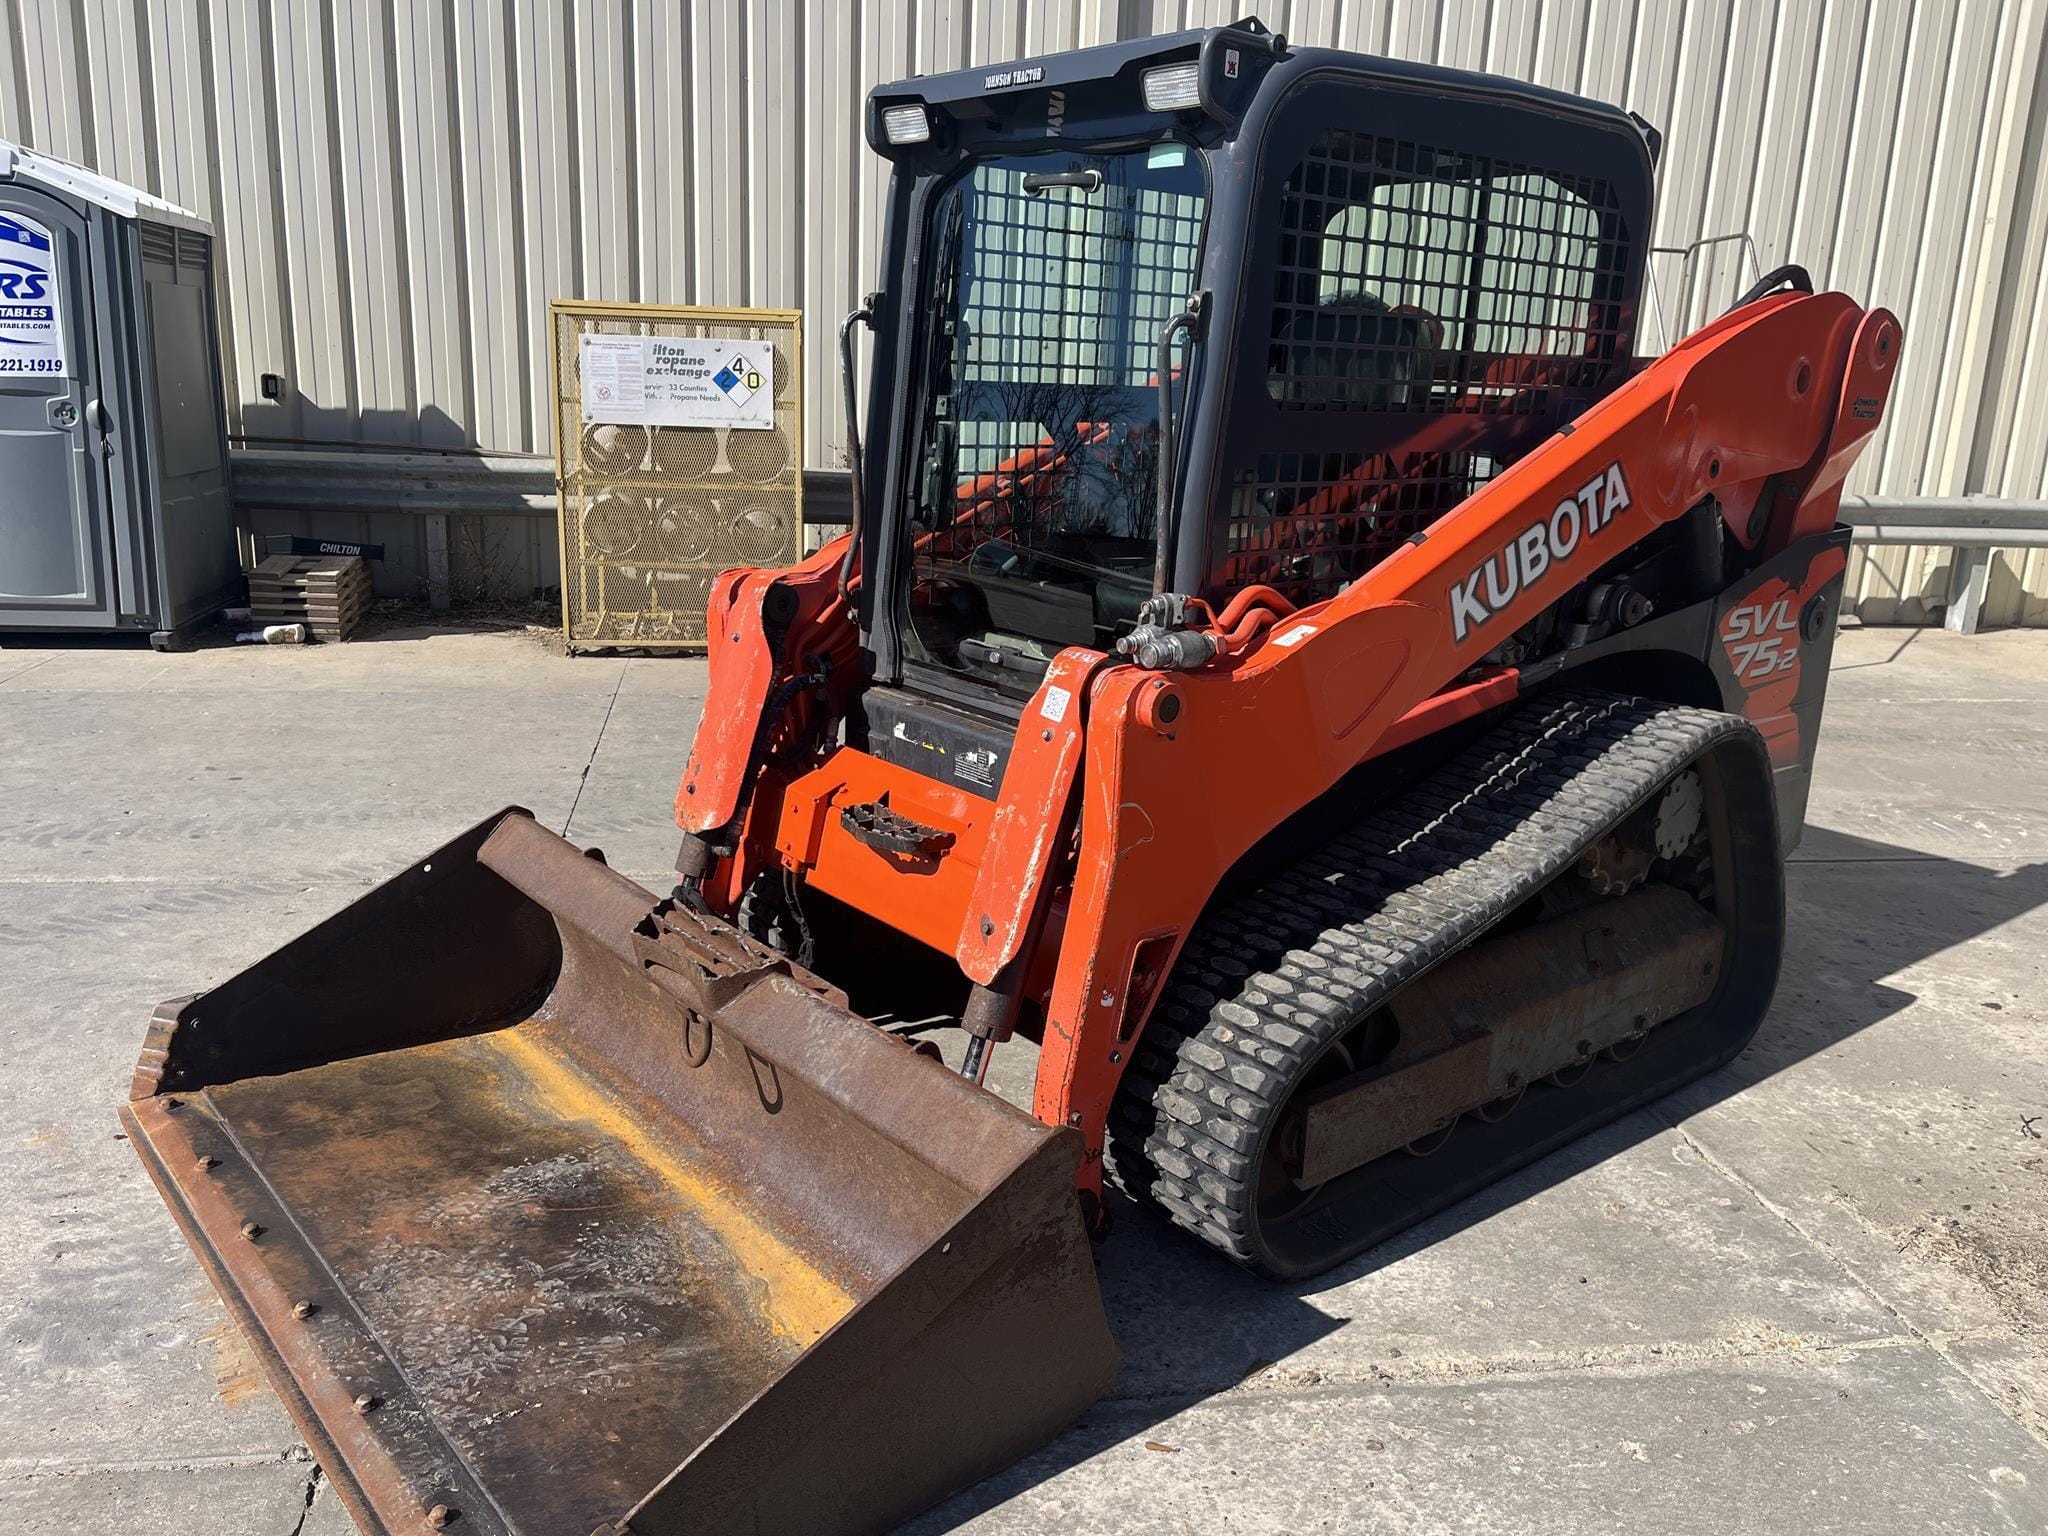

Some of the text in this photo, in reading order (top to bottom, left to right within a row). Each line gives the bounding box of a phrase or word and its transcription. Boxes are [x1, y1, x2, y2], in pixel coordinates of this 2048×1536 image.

[985, 67, 1042, 89] JOHNSON TRACTOR
[0, 308, 47, 318] TABLES
[0, 359, 63, 372] 221-1919
[732, 357, 745, 375] 4
[680, 384, 708, 392] Counties
[719, 371, 731, 388] 2
[747, 372, 759, 389] 0
[670, 393, 698, 402] Propane
[700, 393, 721, 402] Needs
[320, 542, 360, 555] CHILTON
[1450, 463, 1630, 641] KUBOTA
[1722, 600, 1796, 642] SVL
